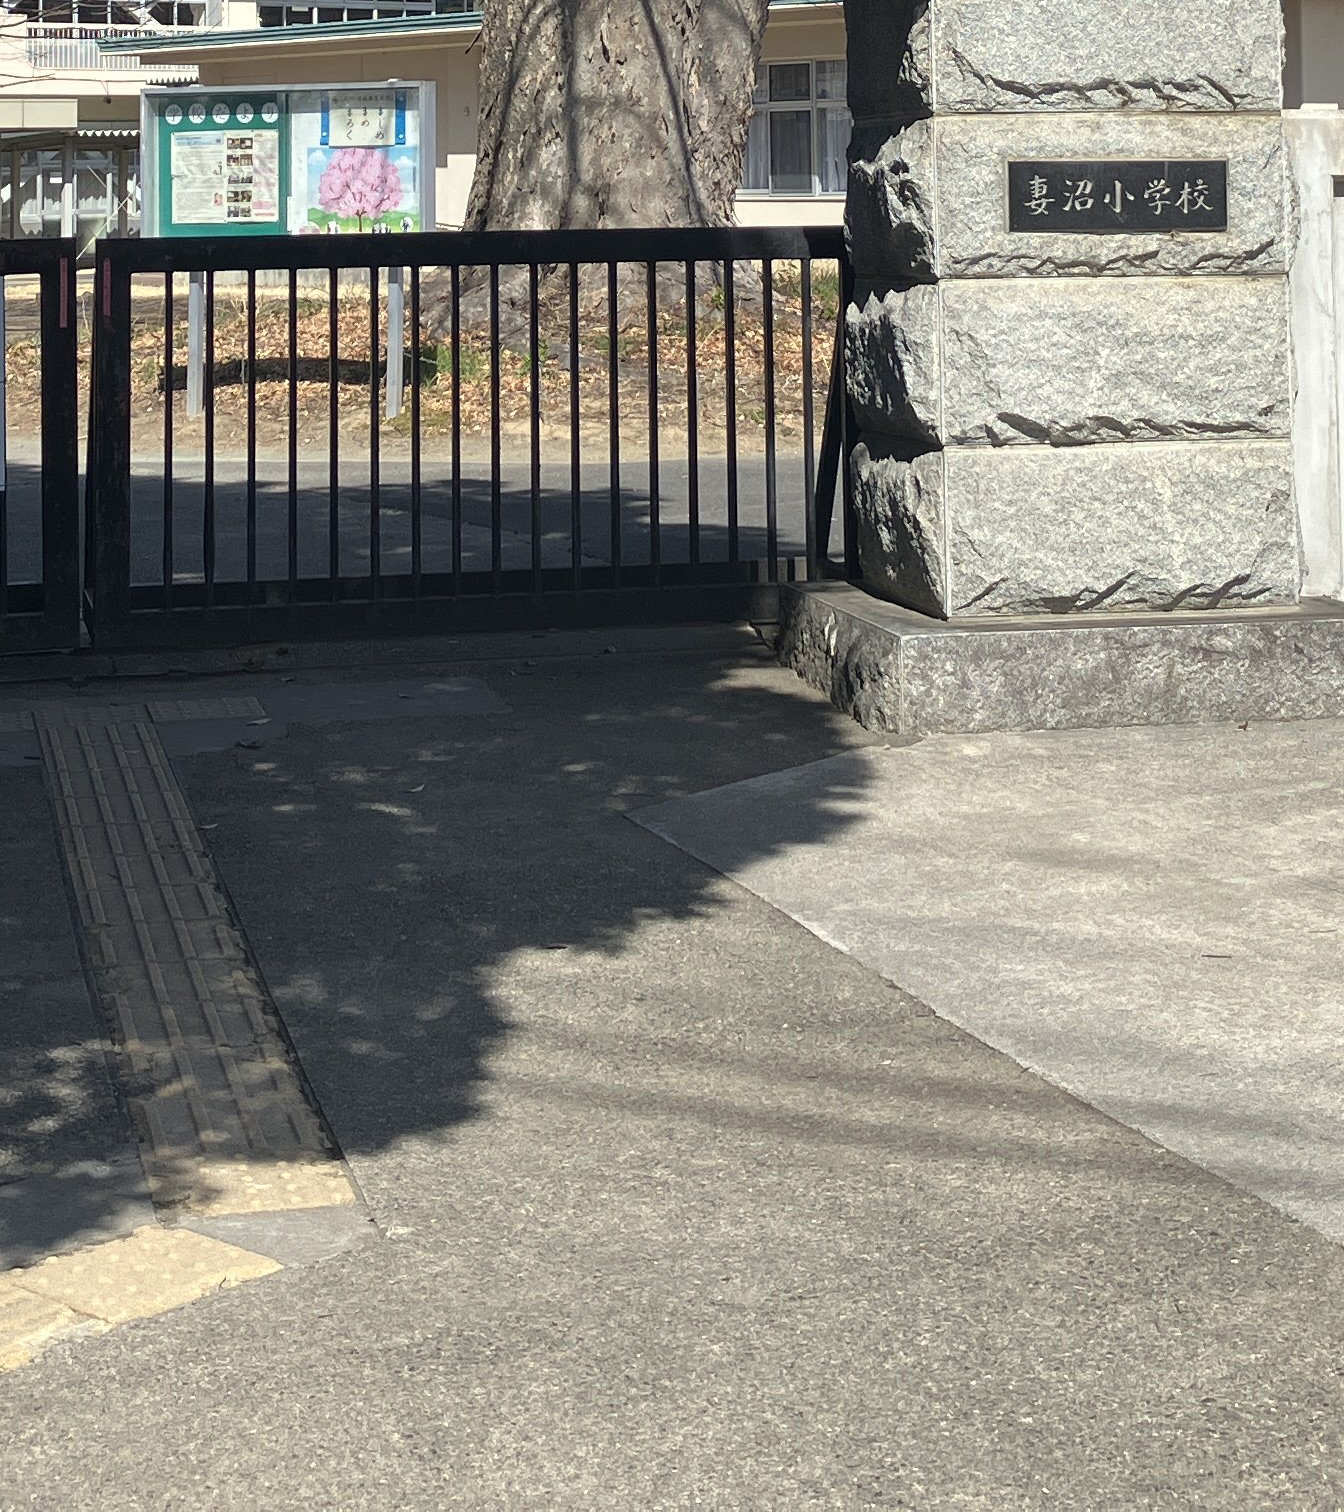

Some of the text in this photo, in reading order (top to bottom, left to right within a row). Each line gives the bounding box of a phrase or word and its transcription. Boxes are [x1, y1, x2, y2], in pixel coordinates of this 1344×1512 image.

[1023, 174, 1214, 215] 妻沼小学校
